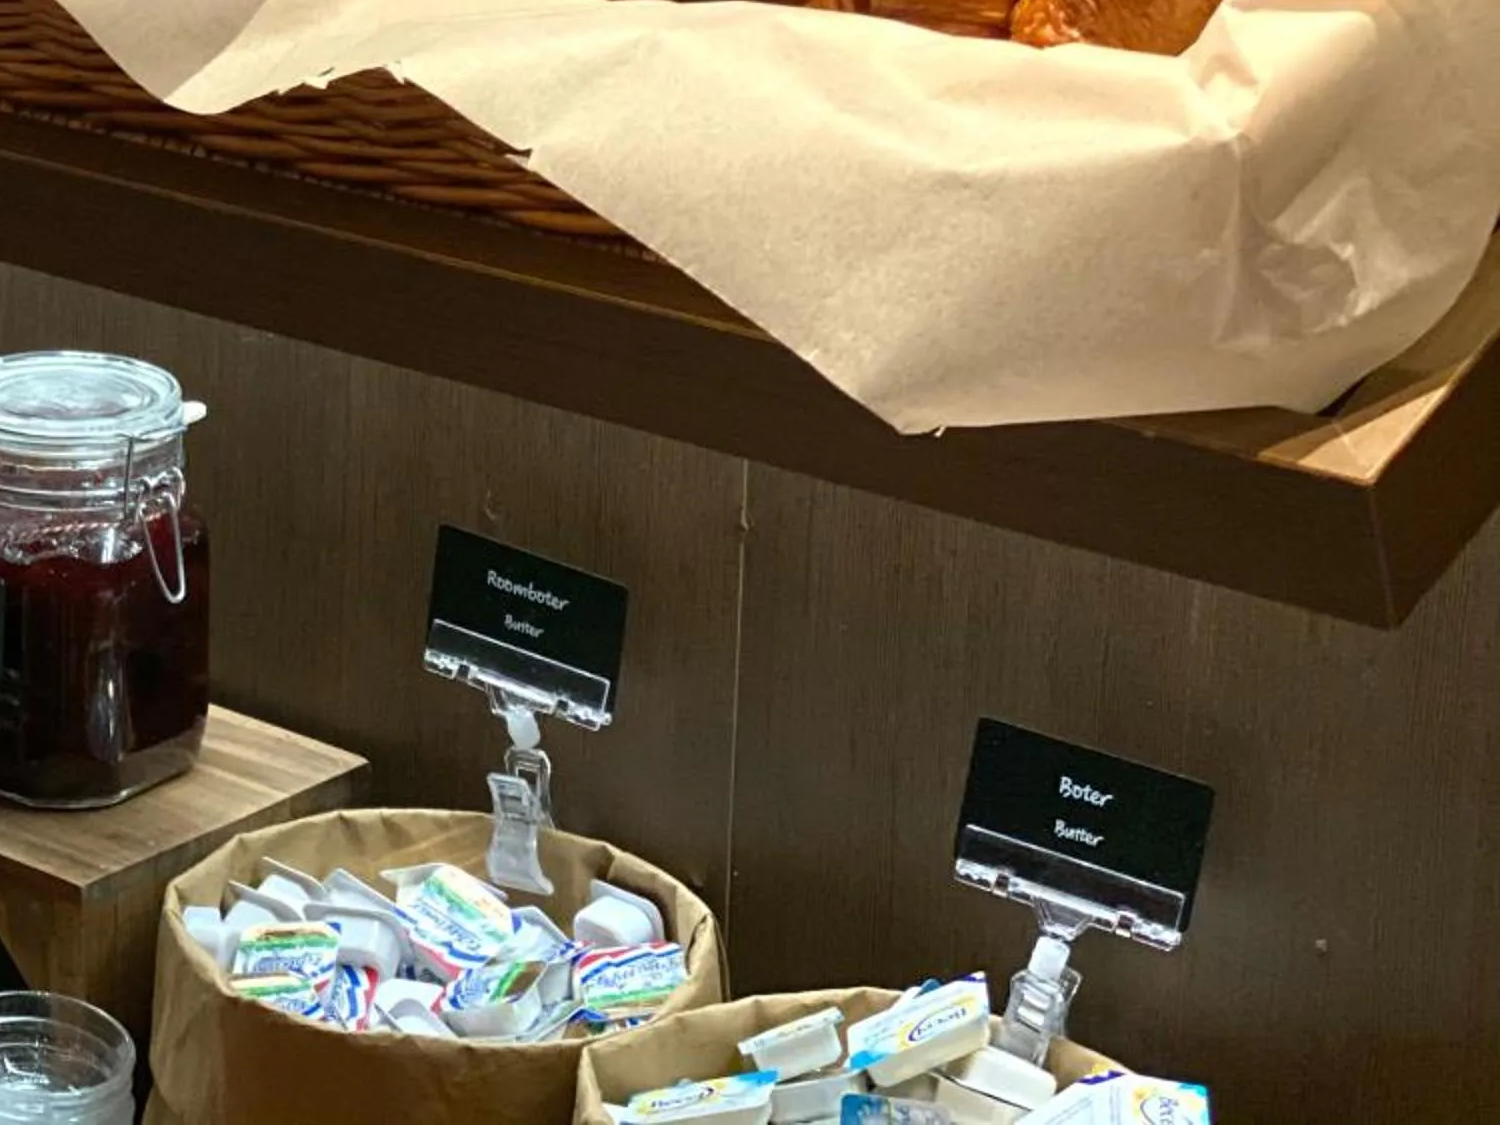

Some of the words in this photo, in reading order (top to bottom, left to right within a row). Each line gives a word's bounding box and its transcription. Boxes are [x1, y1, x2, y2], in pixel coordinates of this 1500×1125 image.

[486, 569, 570, 611] Roomboter
[503, 613, 545, 639] Butter
[1059, 775, 1114, 807] Boter
[1053, 819, 1105, 848] Butter
